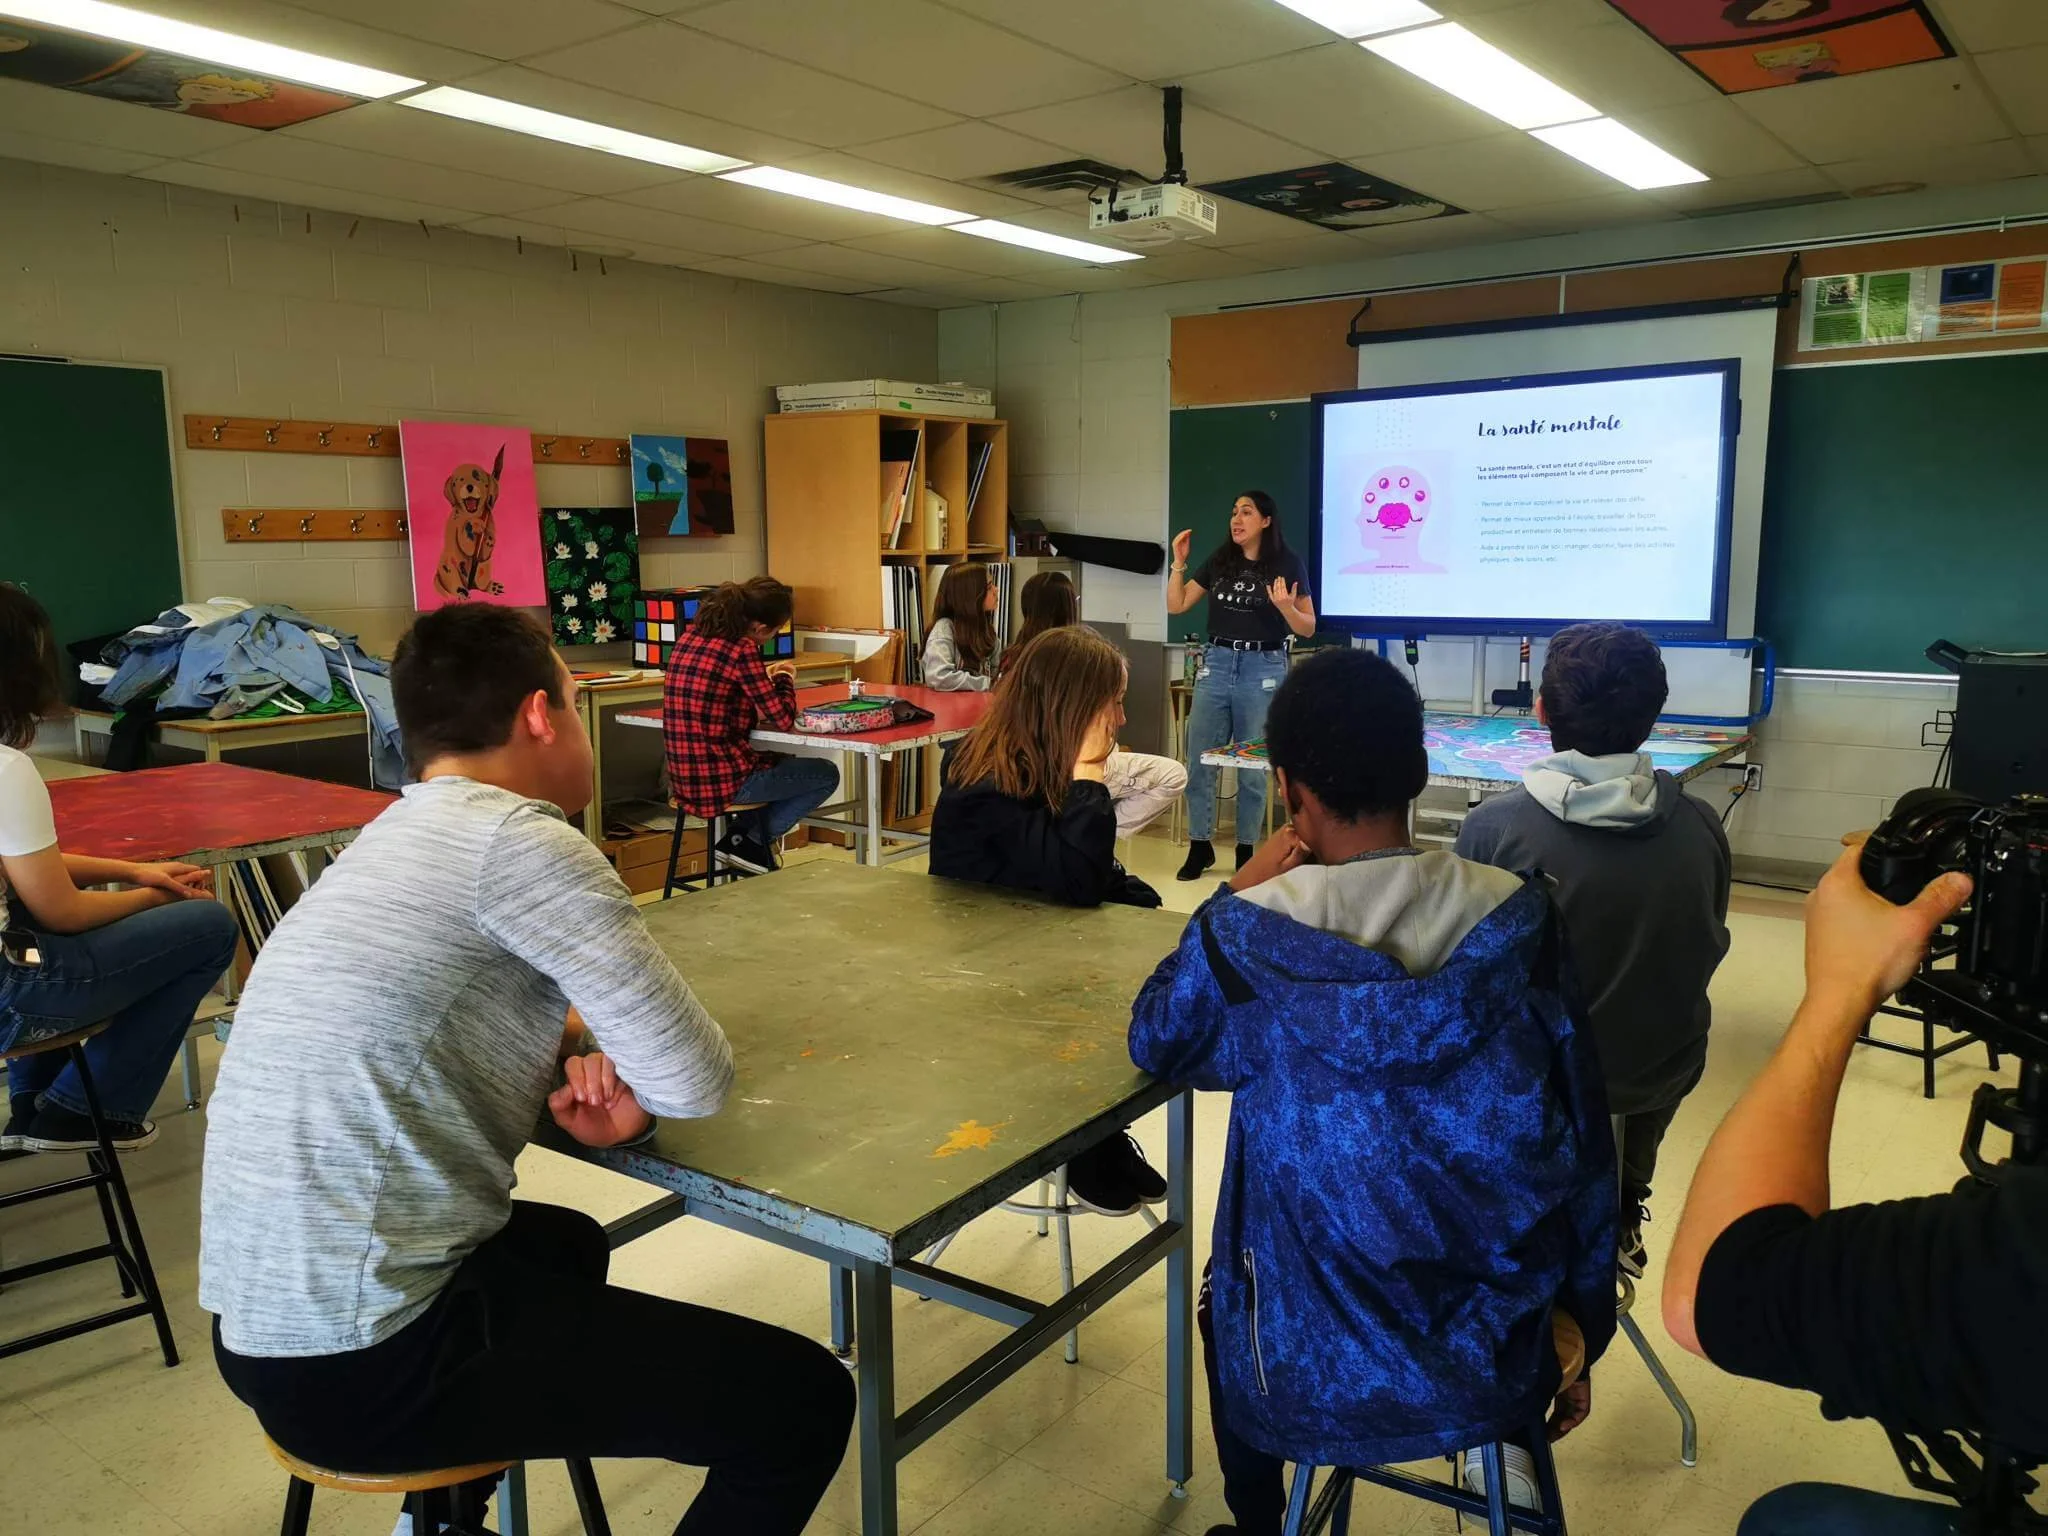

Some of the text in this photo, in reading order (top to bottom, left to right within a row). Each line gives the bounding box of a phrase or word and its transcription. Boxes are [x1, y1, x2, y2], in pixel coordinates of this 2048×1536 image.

[1478, 414, 1622, 436] La santé mentale
